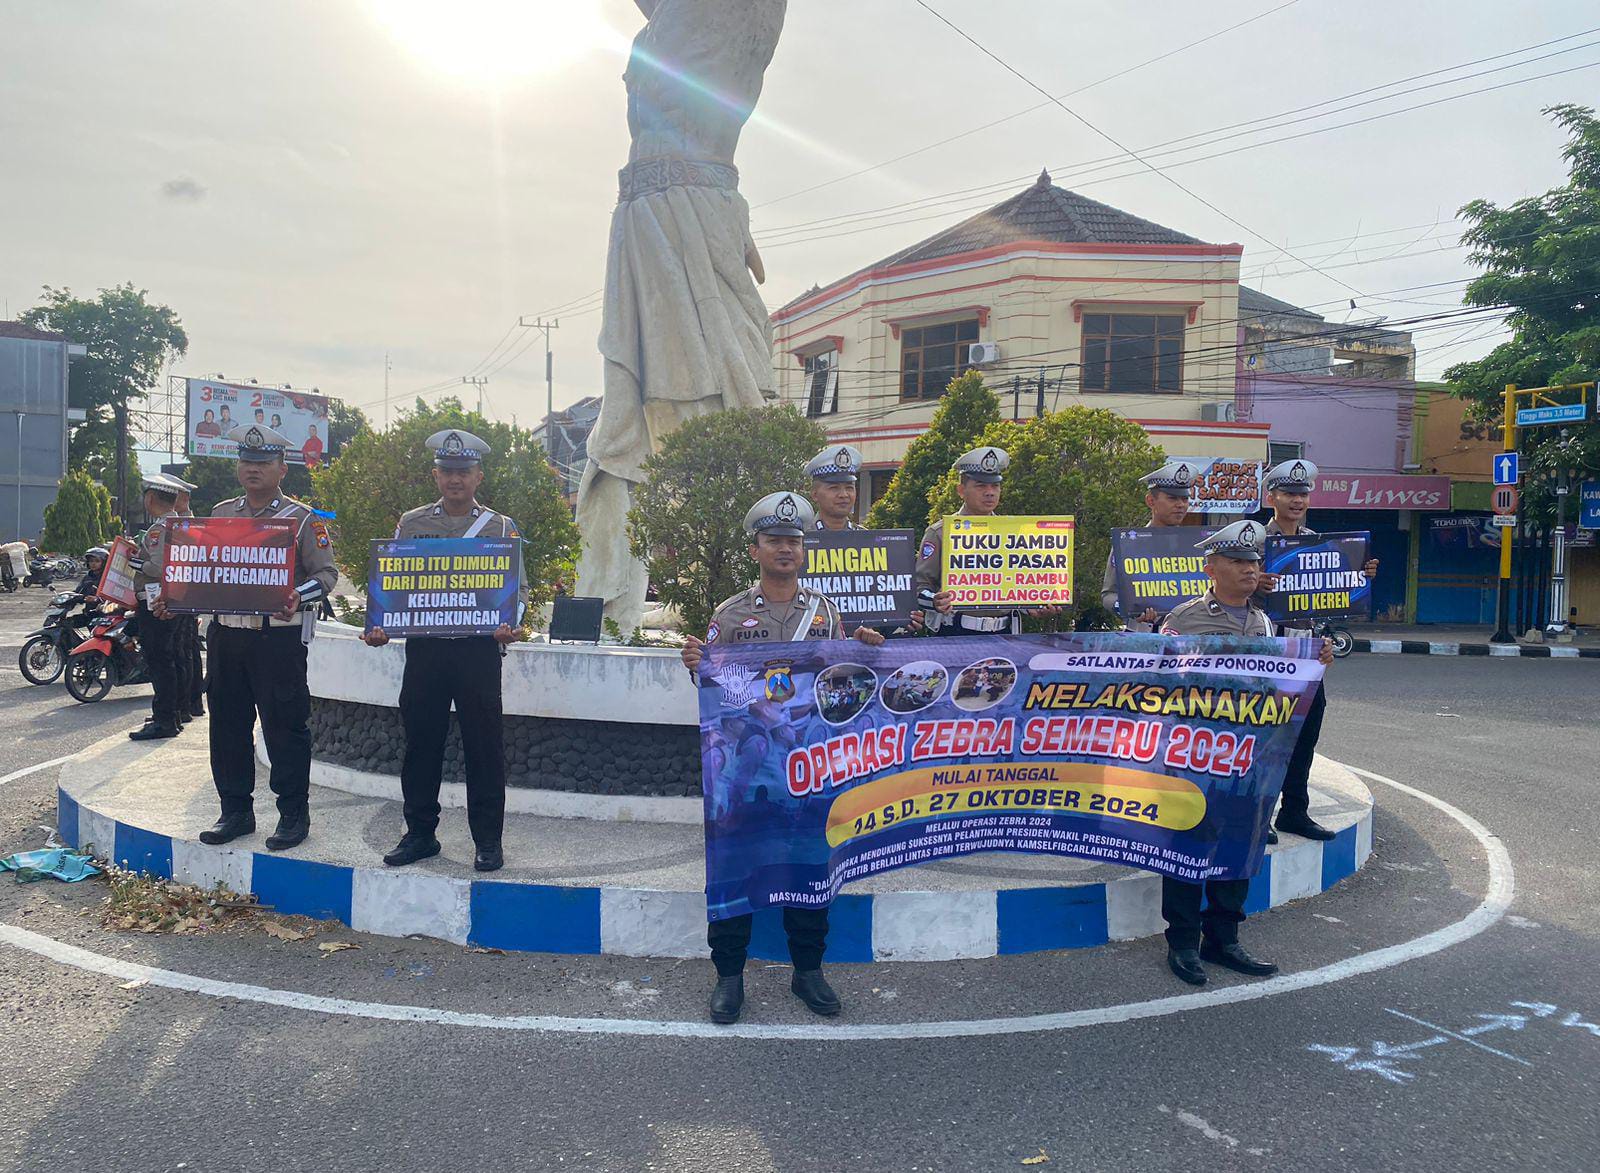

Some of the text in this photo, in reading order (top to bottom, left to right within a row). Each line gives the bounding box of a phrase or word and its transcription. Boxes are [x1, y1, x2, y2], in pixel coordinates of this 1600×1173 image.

[200, 386, 213, 401] 3
[1520, 412, 1537, 421] Tinggi
[1212, 463, 1258, 475] PUSAT
[1208, 474, 1258, 488] POLOS
[1198, 487, 1258, 500] SABLON
[1323, 480, 1347, 491] MAS
[1348, 480, 1441, 505] Luwes
[951, 534, 1067, 550] TUKU JAMBU
[170, 545, 287, 564] RODA 4 GUNAKAN
[806, 547, 888, 574] JANGAN
[950, 554, 1066, 569] NENG PASAR
[1298, 552, 1340, 570] TERTIB
[378, 556, 510, 572] TERTIB ITU DIMULAI
[1124, 557, 1205, 575] OJO NGEBUT
[165, 567, 288, 586] SABUK PENGAMAN
[383, 574, 504, 590] DARI DIRI SENDIRI
[855, 576, 874, 592] HP
[877, 574, 912, 591] SAAT
[948, 573, 1001, 586] RAMBU
[1015, 572, 1068, 585] RAMBU
[1325, 571, 1367, 589] LINTAS
[949, 589, 1070, 602] OJO DILANGGAR
[1132, 581, 1178, 597] TIWAS
[408, 592, 477, 608] KELUARGA
[1289, 592, 1350, 612] ITU KEREN
[383, 610, 500, 628] DAN LINGKUNGAN
[737, 629, 769, 640] FUAD
[809, 628, 830, 637] OLRI
[1067, 656, 1296, 674] SATLANTAS POLRES PONOROGO
[1024, 683, 1300, 725] MELAKSANAKAN
[787, 716, 1255, 796] OPERASI ZEBRA SEMERU 2024
[932, 767, 1059, 785] MULAI TANGGAL
[883, 798, 920, 825] S.D.
[929, 792, 959, 812] 27
[968, 789, 1080, 809] OKTOBER
[1090, 793, 1159, 821] 2024
[925, 816, 1051, 833] MELALUI OPERASI ZEBRA 2024
[860, 842, 906, 862] MENDUKUNG
[909, 833, 953, 849] SUKSESNYA
[954, 827, 1004, 841] PELANTIKAN
[1006, 827, 1080, 842] PRESIDEN/WAKIL
[1083, 833, 1128, 849] PRESIDEN
[1131, 840, 1160, 855] SERTA
[769, 890, 831, 904] MASYARAKAT
[843, 864, 868, 879] TERTIB
[870, 856, 903, 871] BERLALU
[905, 848, 931, 861] LINTAS
[932, 845, 954, 856] DEMI
[954, 838, 1014, 853] TERWUJUDNYA
[1122, 852, 1146, 866] YANG
[1148, 858, 1176, 875] AMAN
[1178, 865, 1197, 880] DAN
